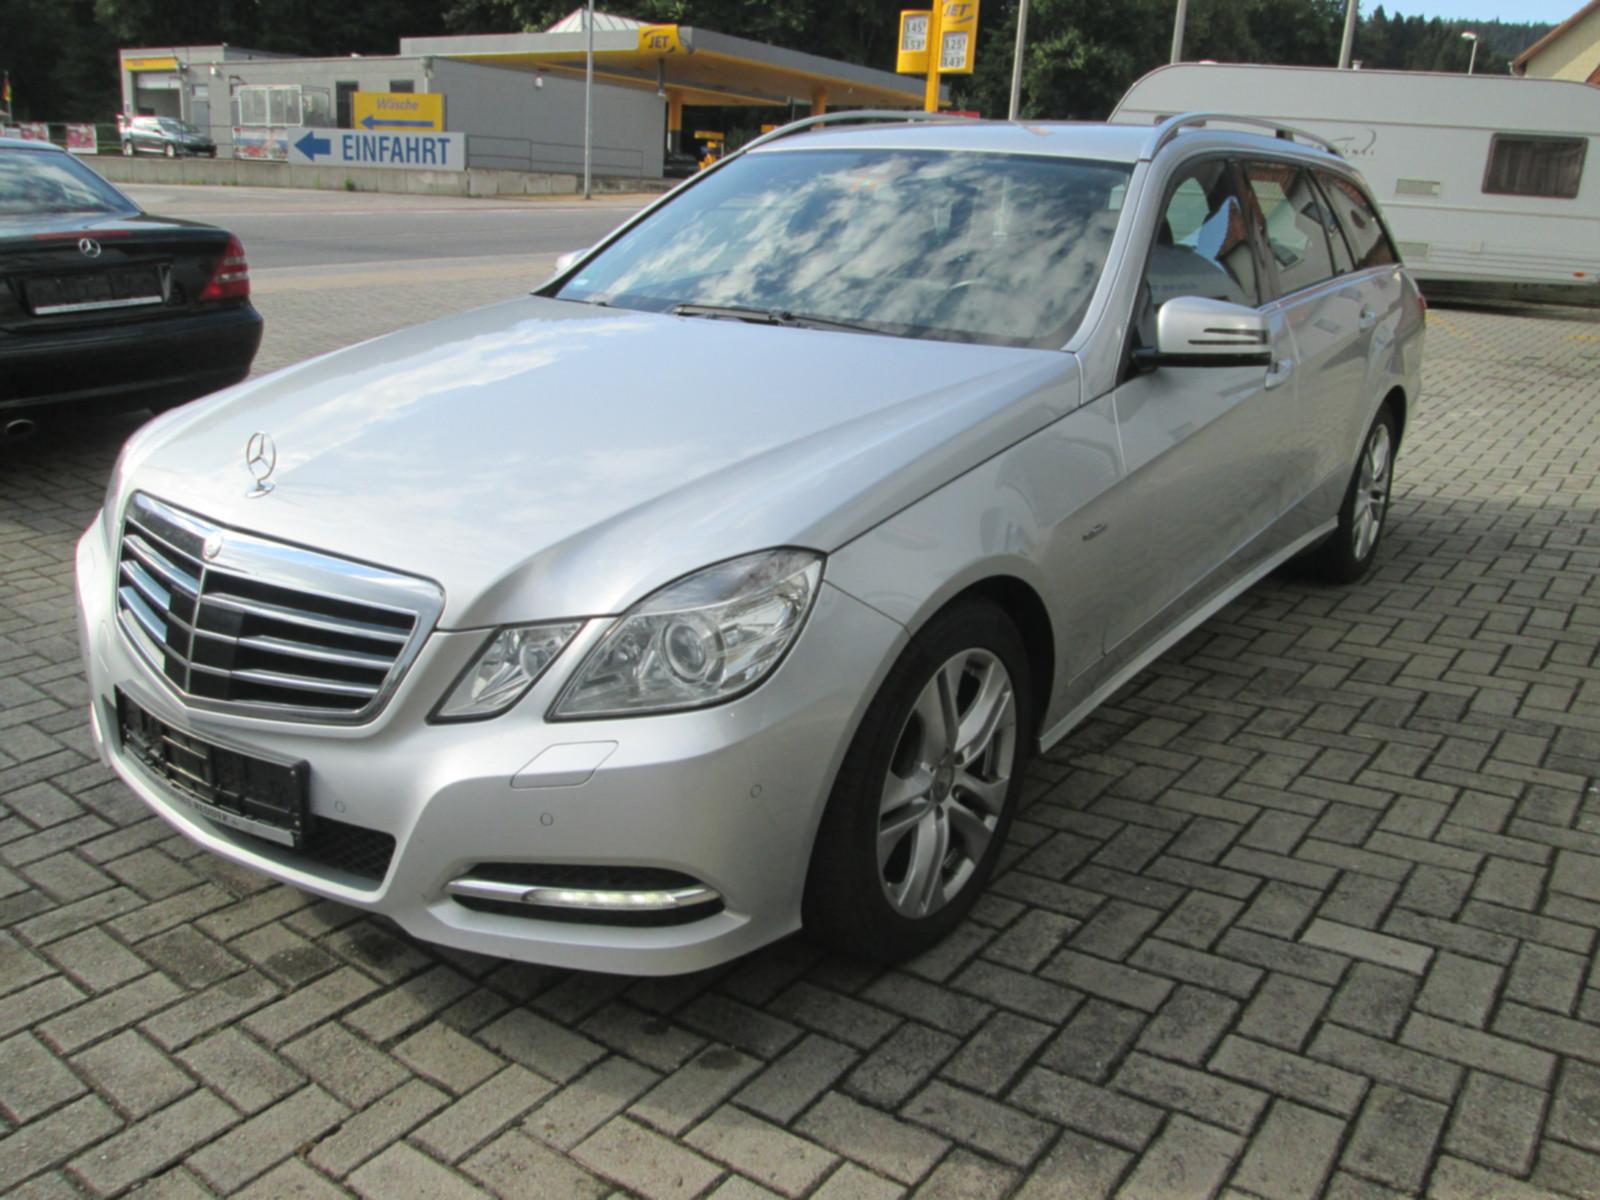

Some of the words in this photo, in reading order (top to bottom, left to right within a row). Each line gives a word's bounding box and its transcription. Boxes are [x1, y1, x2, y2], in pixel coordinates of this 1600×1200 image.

[944, 4, 971, 17] JET
[648, 36, 670, 49] JET
[342, 134, 451, 165] EINFAHRT
